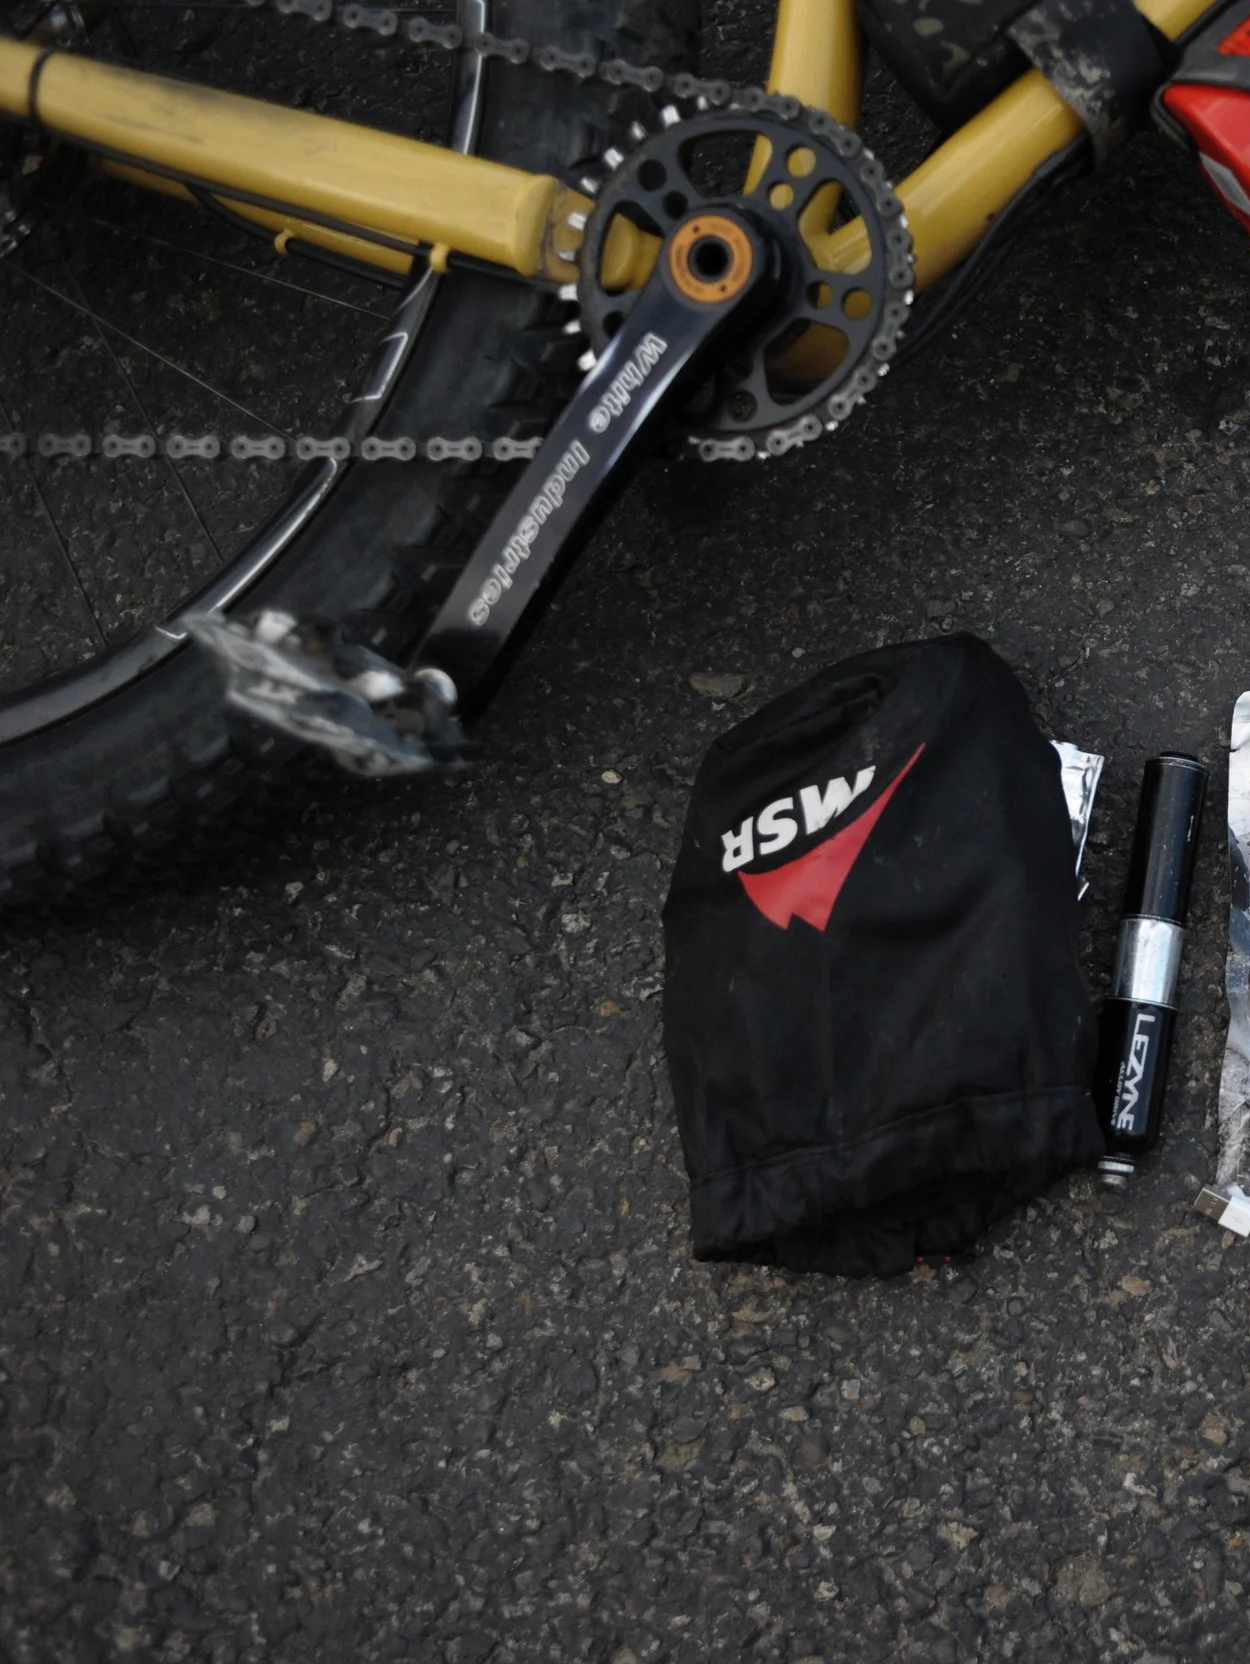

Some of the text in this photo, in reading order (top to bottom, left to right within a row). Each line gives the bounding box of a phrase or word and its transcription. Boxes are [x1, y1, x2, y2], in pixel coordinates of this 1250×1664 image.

[466, 332, 669, 627] White Industries
[721, 765, 876, 873] MSR
[1116, 1013, 1156, 1131] LEZYNE
